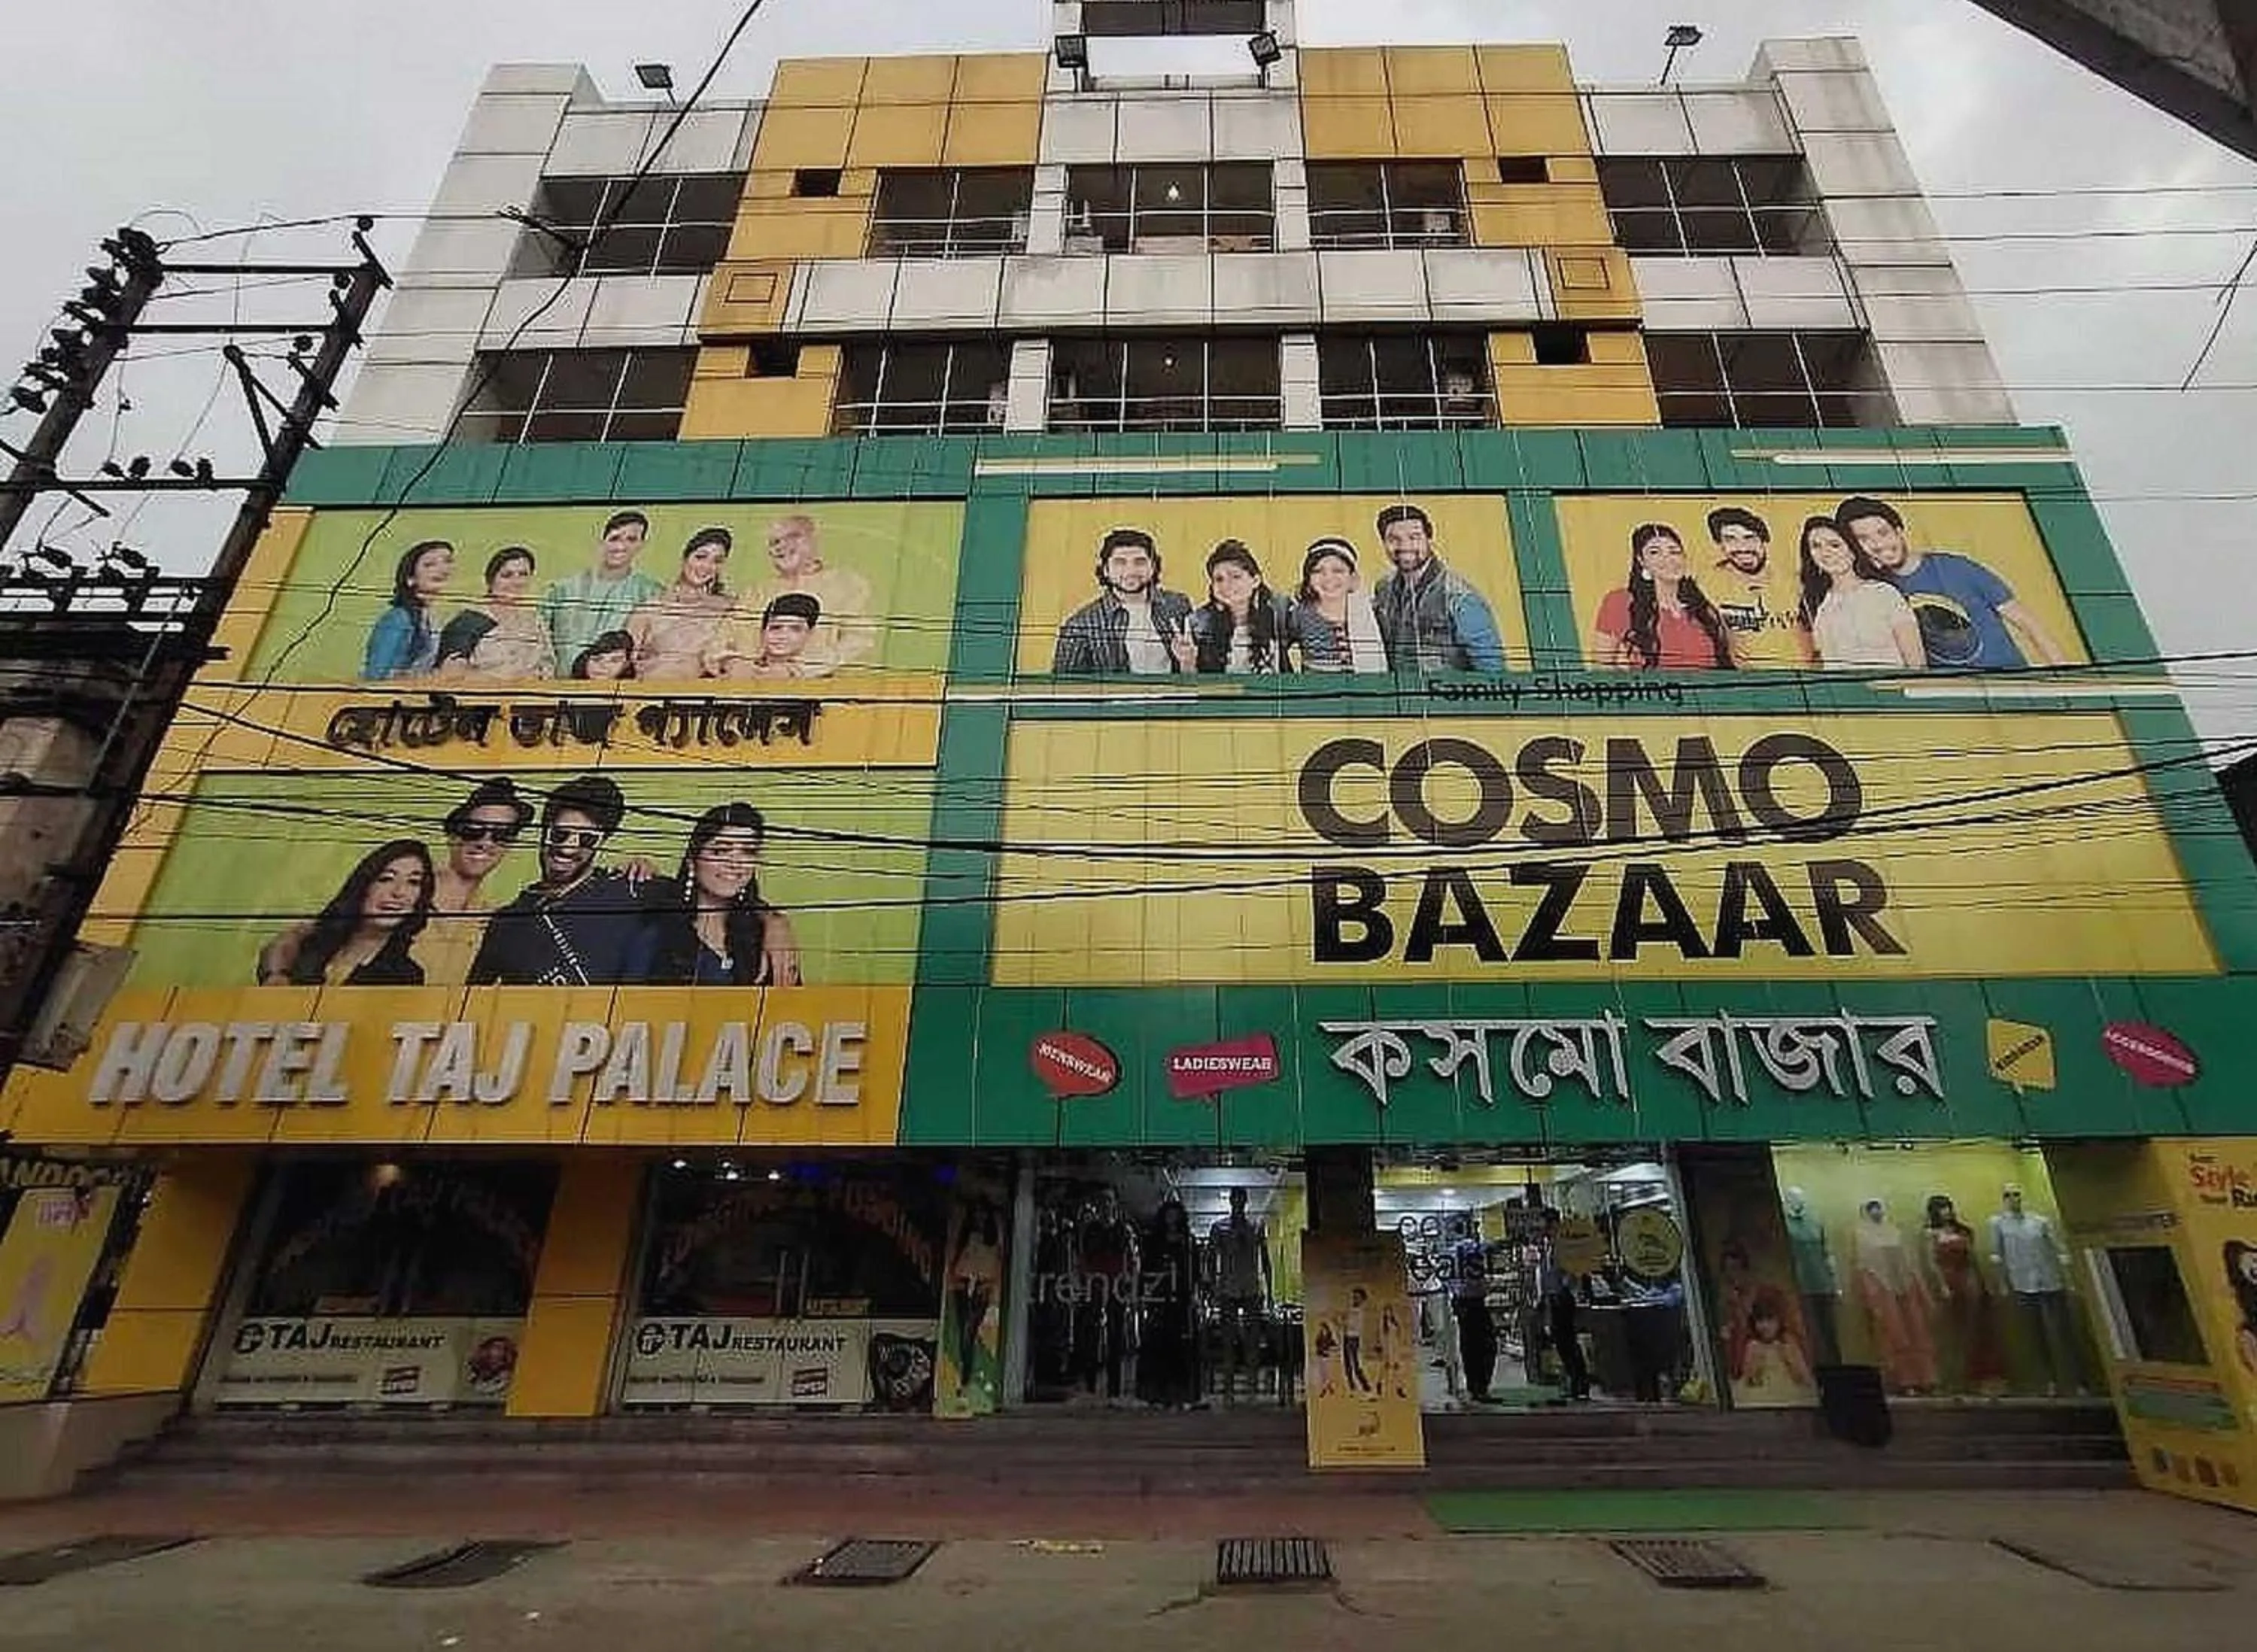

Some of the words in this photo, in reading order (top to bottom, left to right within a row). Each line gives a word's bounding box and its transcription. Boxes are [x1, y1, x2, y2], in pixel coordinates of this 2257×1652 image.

[1429, 679, 1520, 709] Family
[1534, 677, 1684, 708] Shopping
[1297, 733, 1863, 847] COSMO
[1311, 860, 1907, 964] BAZAAR
[88, 1020, 349, 1104] HOTEL
[387, 1020, 536, 1104] TAJ
[548, 1019, 870, 1106] PALACE
[1172, 1055, 1271, 1073] LADIESWEAR
[1318, 1009, 1628, 1104] কসমো
[1643, 1007, 1944, 1104] বাজার
[1026, 1261, 1178, 1305] rendz!
[269, 1323, 333, 1350] TAJ
[669, 1323, 734, 1350] TAJ
[732, 1335, 847, 1353] RESTAURANT
